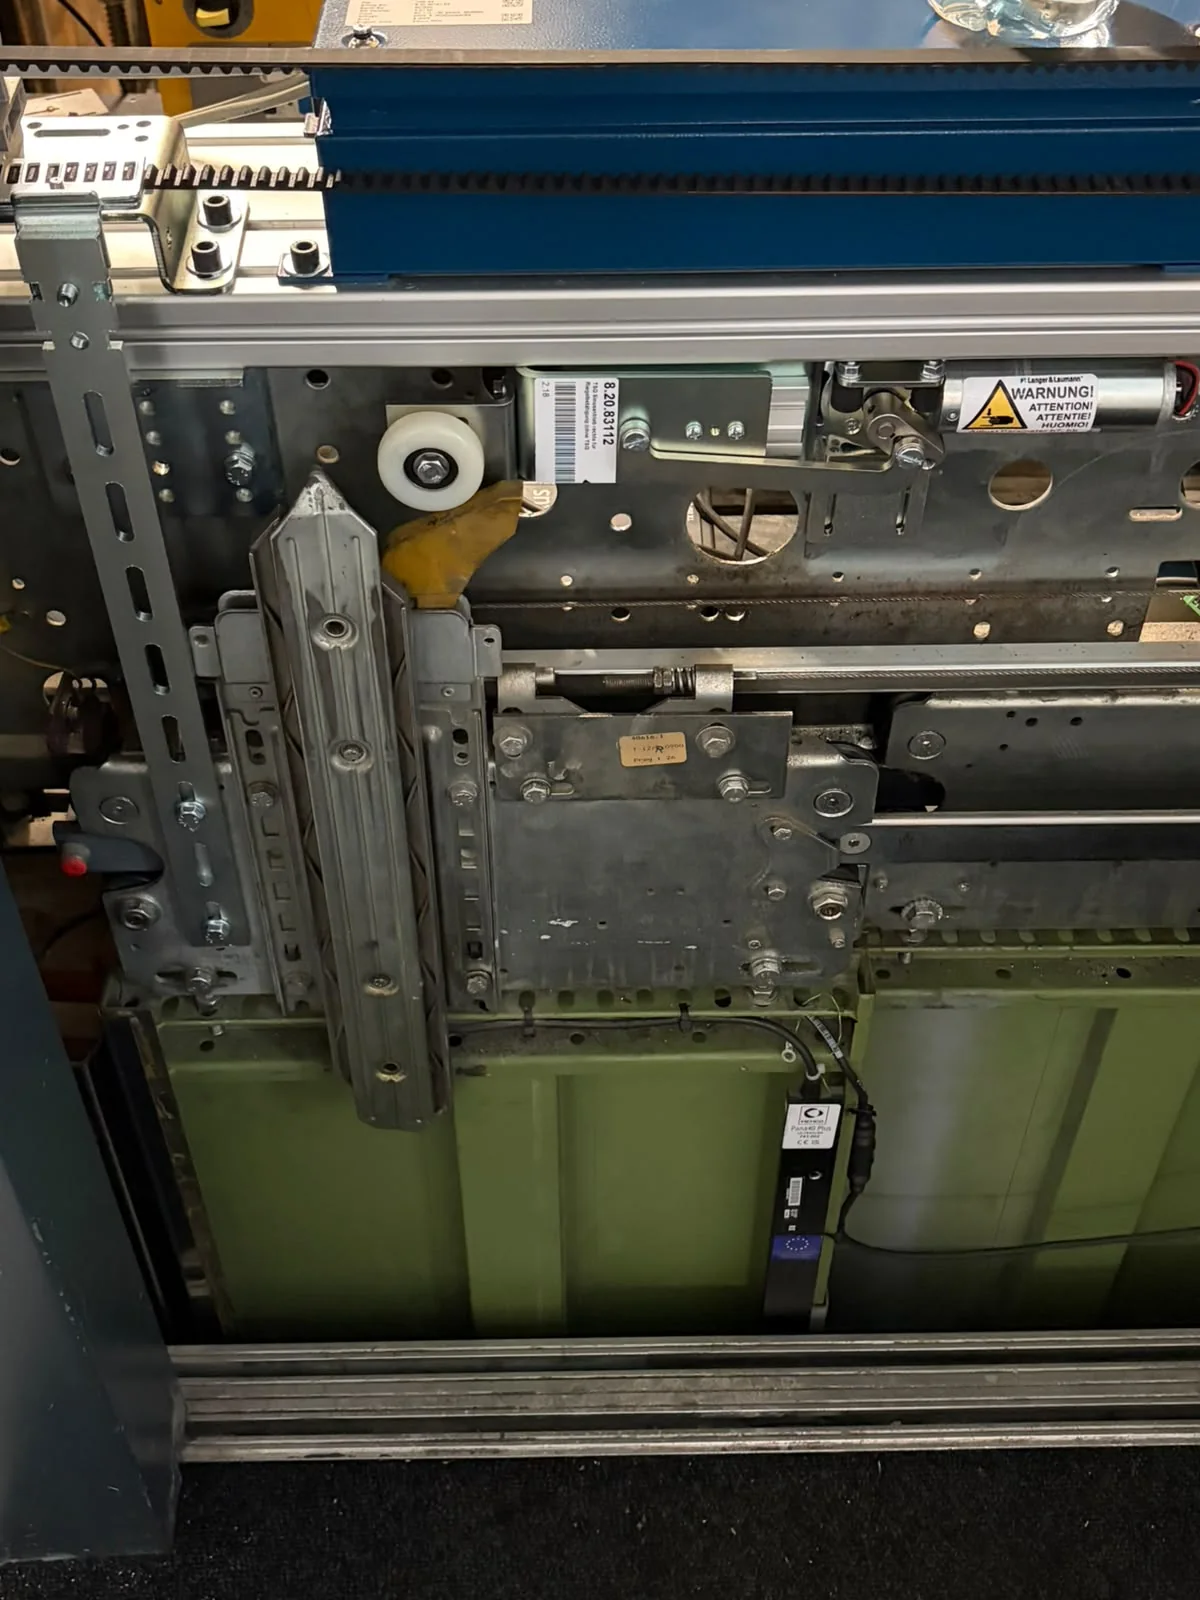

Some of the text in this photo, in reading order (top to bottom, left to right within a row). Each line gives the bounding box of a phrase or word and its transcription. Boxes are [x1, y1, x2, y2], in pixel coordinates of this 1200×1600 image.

[541, 381, 550, 398] 2.18
[1011, 385, 1094, 400] WARNUNG!
[603, 382, 616, 445] 8.20.83112
[1028, 402, 1093, 411] ATTENTION!
[1036, 412, 1091, 421] ATTENTIE!
